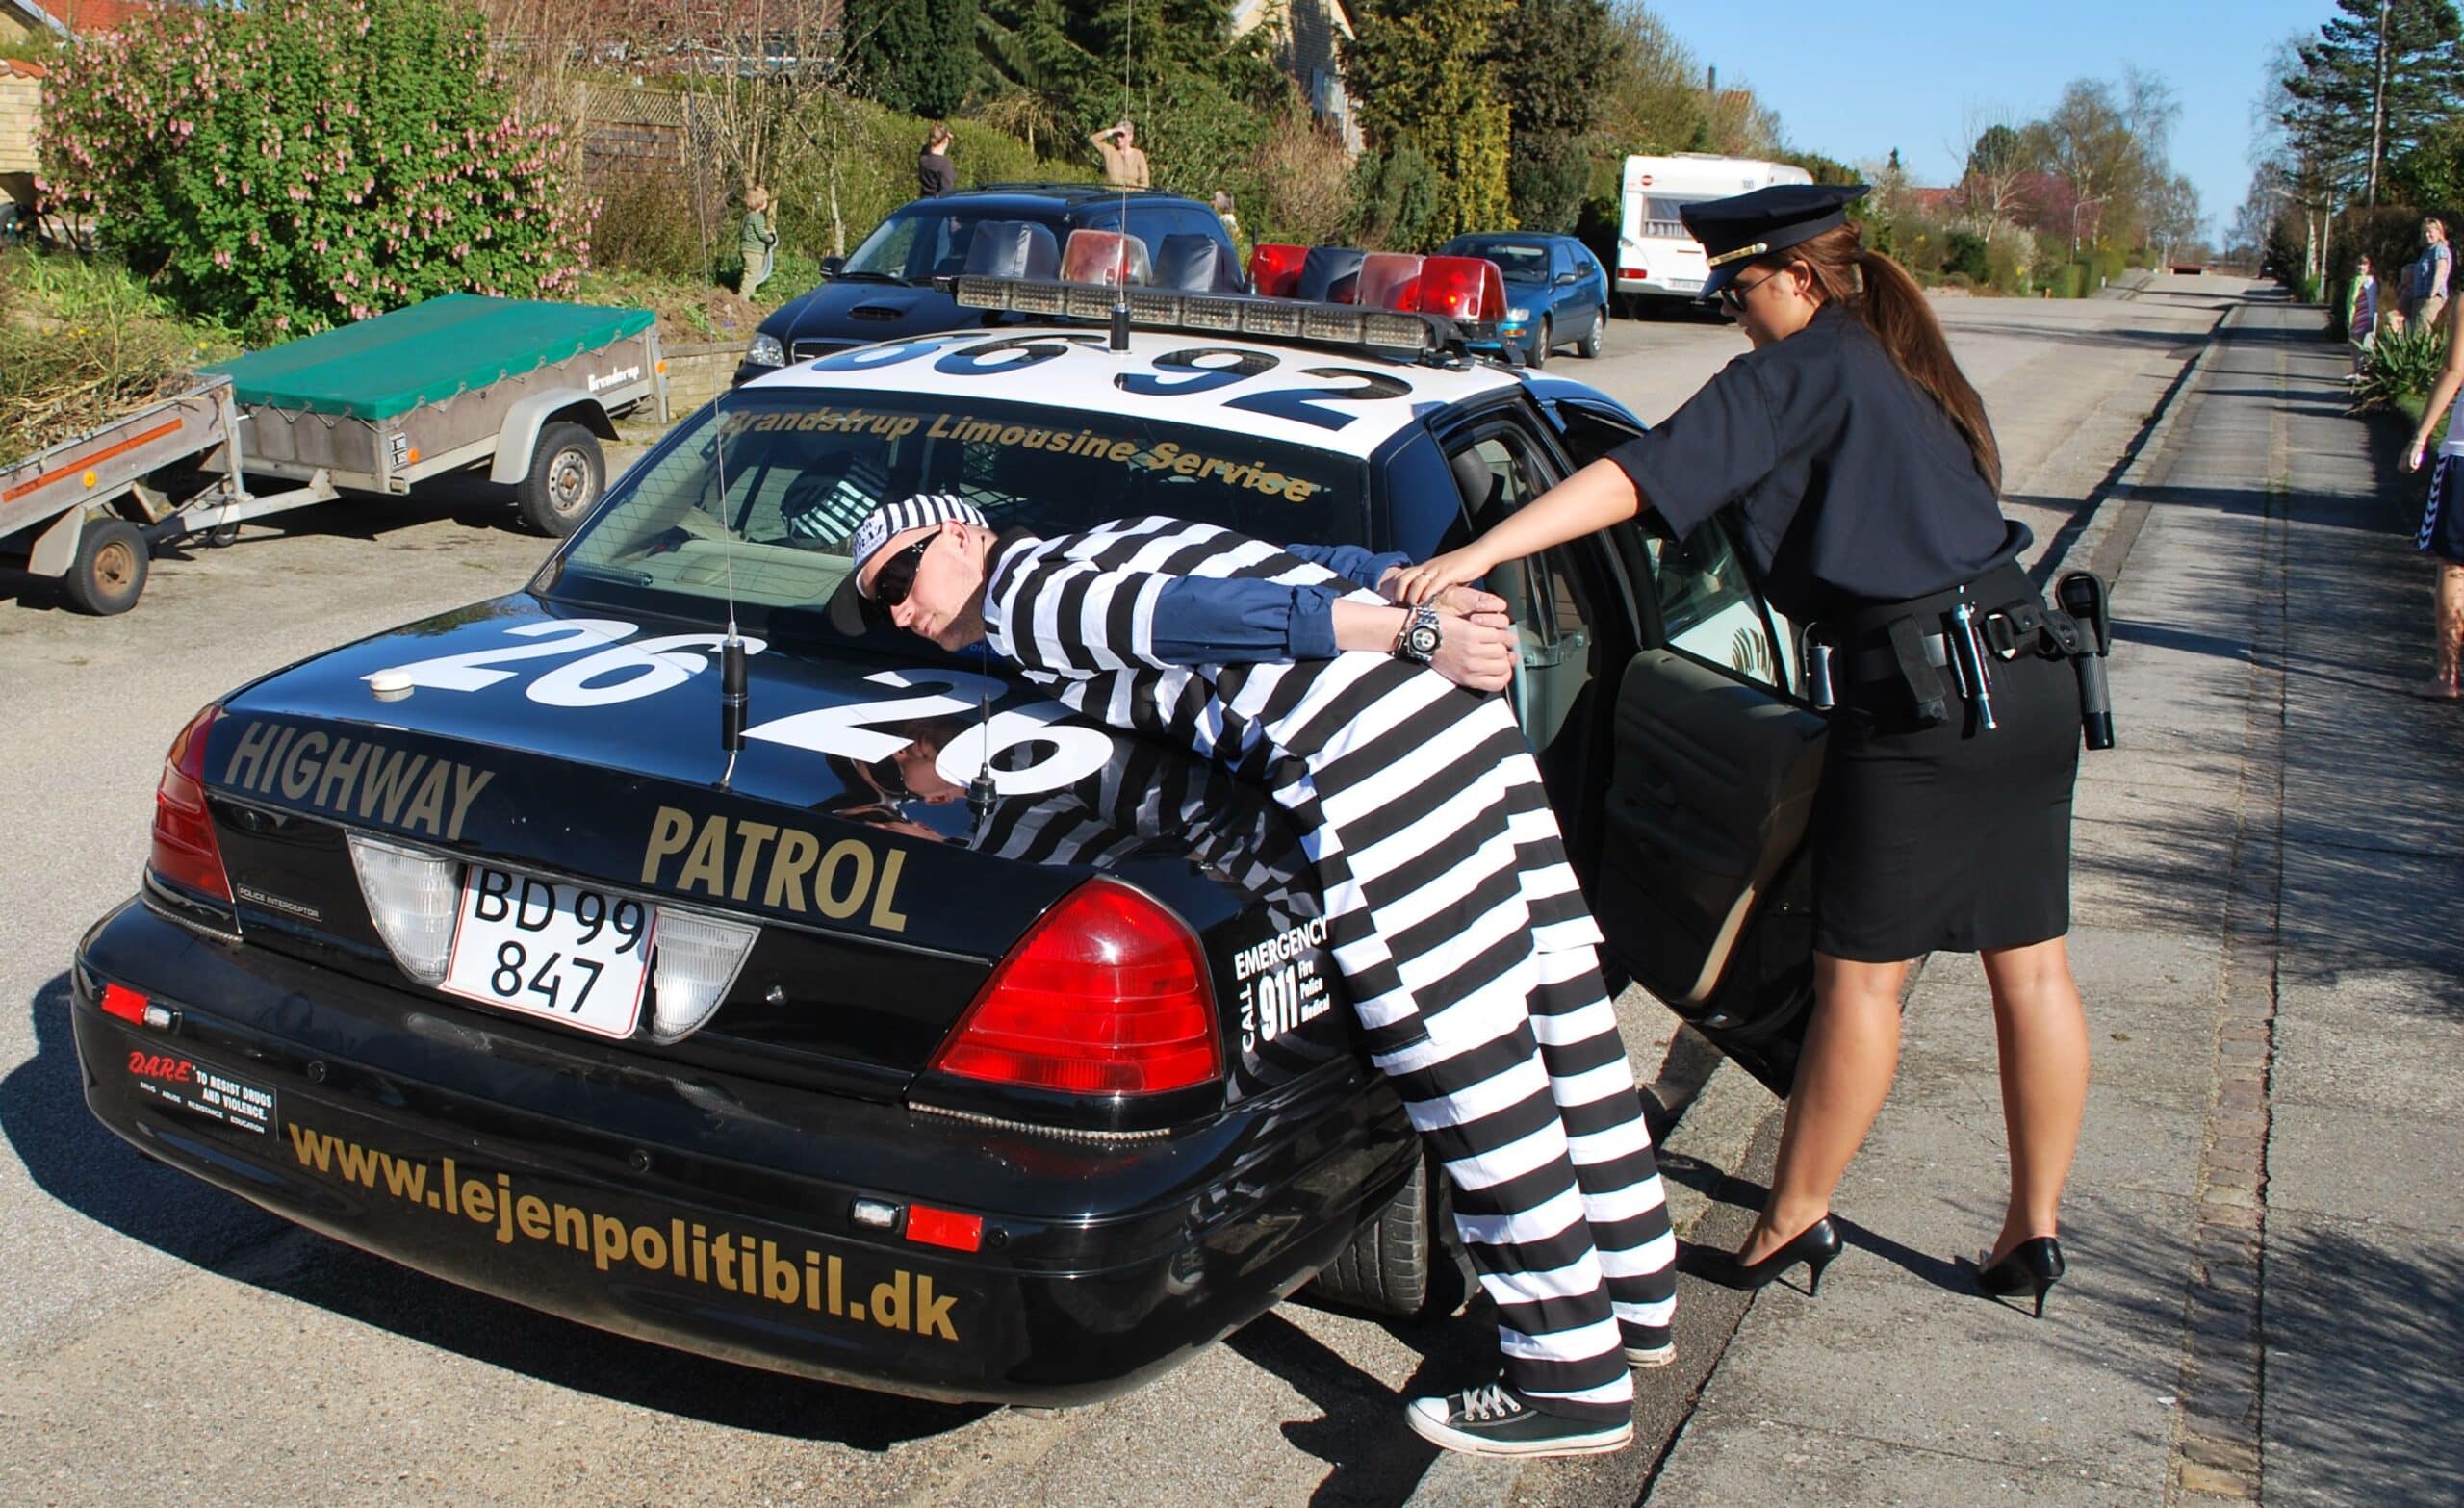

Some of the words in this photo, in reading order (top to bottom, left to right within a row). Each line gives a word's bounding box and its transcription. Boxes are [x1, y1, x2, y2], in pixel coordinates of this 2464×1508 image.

[721, 407, 920, 441] Brandstrup
[925, 414, 1137, 462] Limousine
[1147, 442, 1313, 502] Service
[359, 619, 768, 707] 26
[739, 668, 1115, 795] 26
[223, 722, 496, 841] HIGHWAY
[641, 805, 907, 933] PATROL
[240, 887, 265, 902] POLICE
[267, 896, 320, 917] INTERCEPTOR
[475, 868, 556, 933] BD
[575, 893, 646, 955] 99
[490, 940, 604, 1014] 847
[1234, 915, 1329, 981] EMERGENCY
[1298, 960, 1314, 979] Fire
[1240, 982, 1255, 1053] CALL
[1258, 965, 1298, 1042] 911
[1300, 977, 1323, 1000] Police
[1301, 993, 1331, 1023] Medical
[195, 1070, 208, 1086] TO
[209, 1075, 241, 1097] RESIST
[243, 1086, 272, 1109] DRUGS
[202, 1088, 220, 1105] AND
[223, 1094, 268, 1121] VIOLENCE.
[289, 1122, 961, 1342] www.lejenpolitibil.dk
